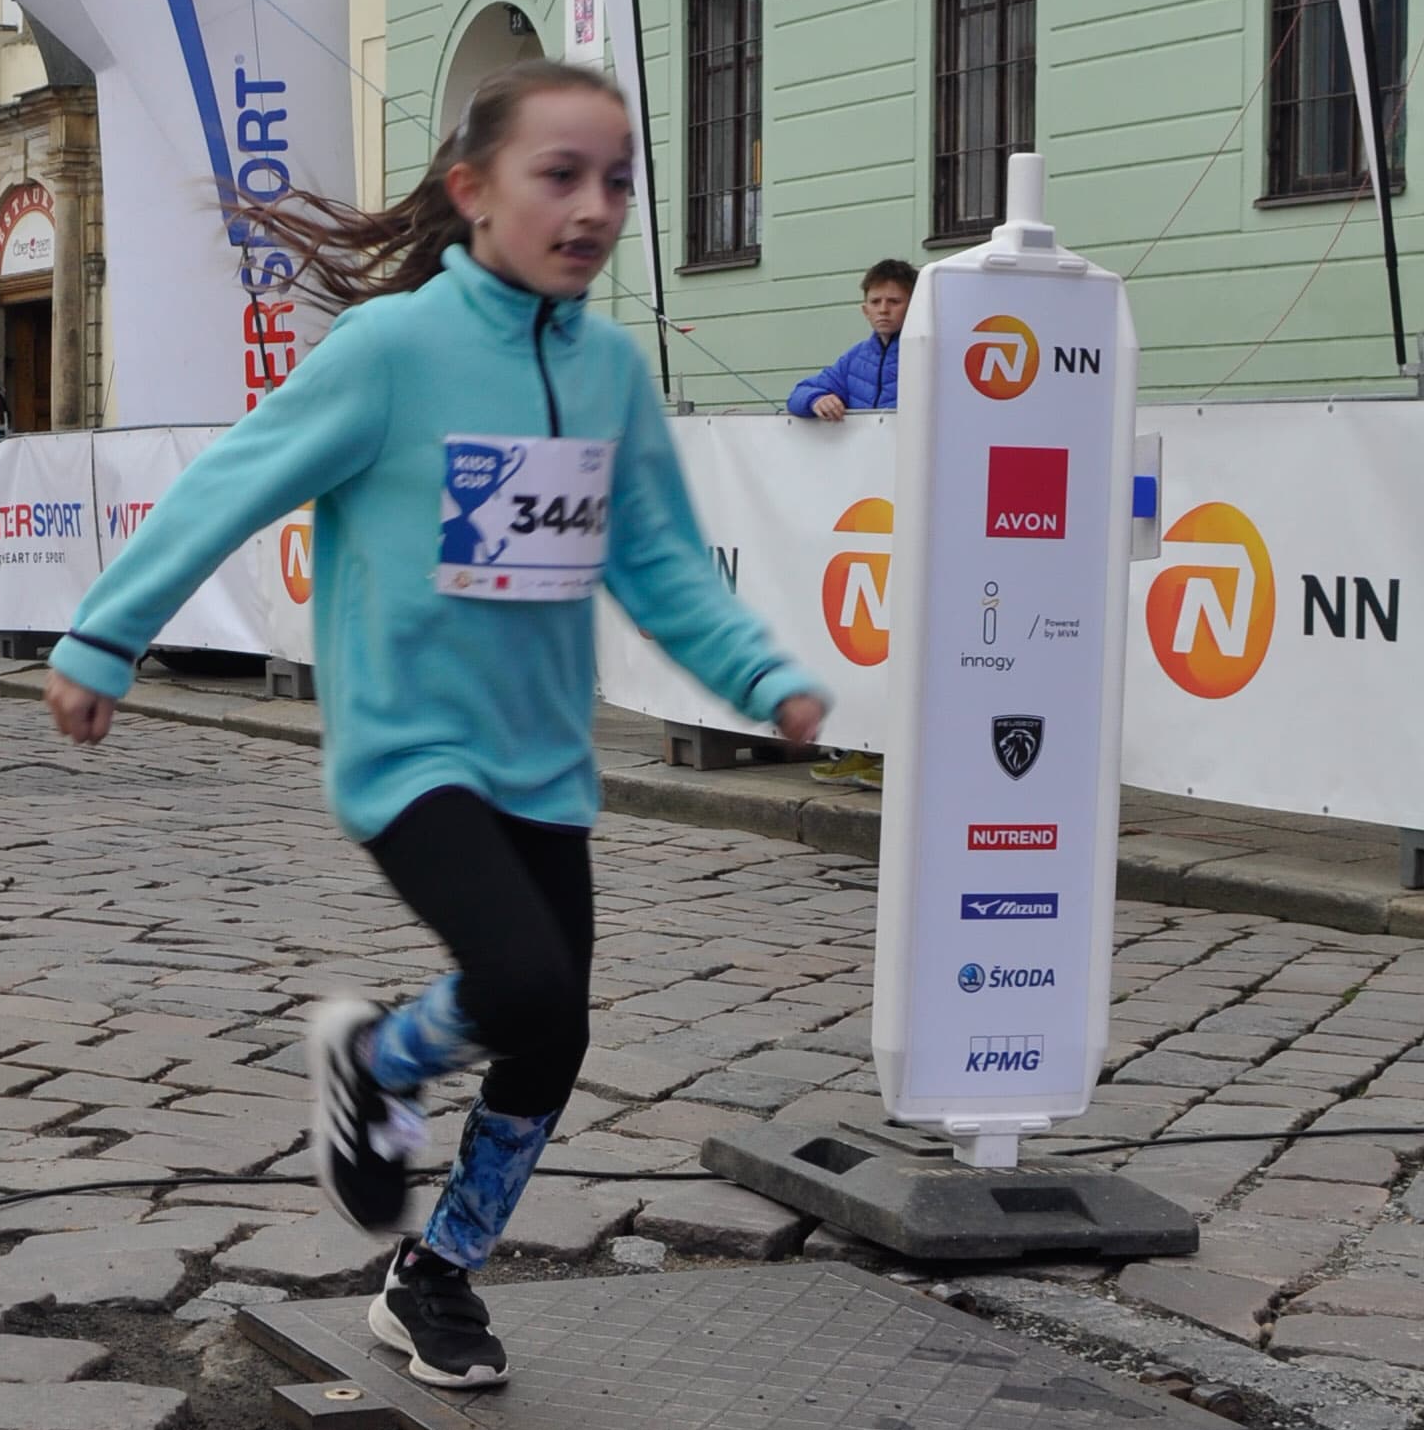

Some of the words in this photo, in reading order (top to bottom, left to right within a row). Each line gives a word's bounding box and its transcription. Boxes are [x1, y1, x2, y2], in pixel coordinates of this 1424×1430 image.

[1053, 345, 1101, 374] NN
[994, 512, 1057, 531] AVON
[708, 546, 738, 595] N
[1302, 573, 1400, 643] NN
[961, 652, 1015, 671] innogy
[973, 829, 1054, 846] NUTREND
[988, 967, 1056, 988] ŠKODA
[965, 1049, 1041, 1072] KPMG
